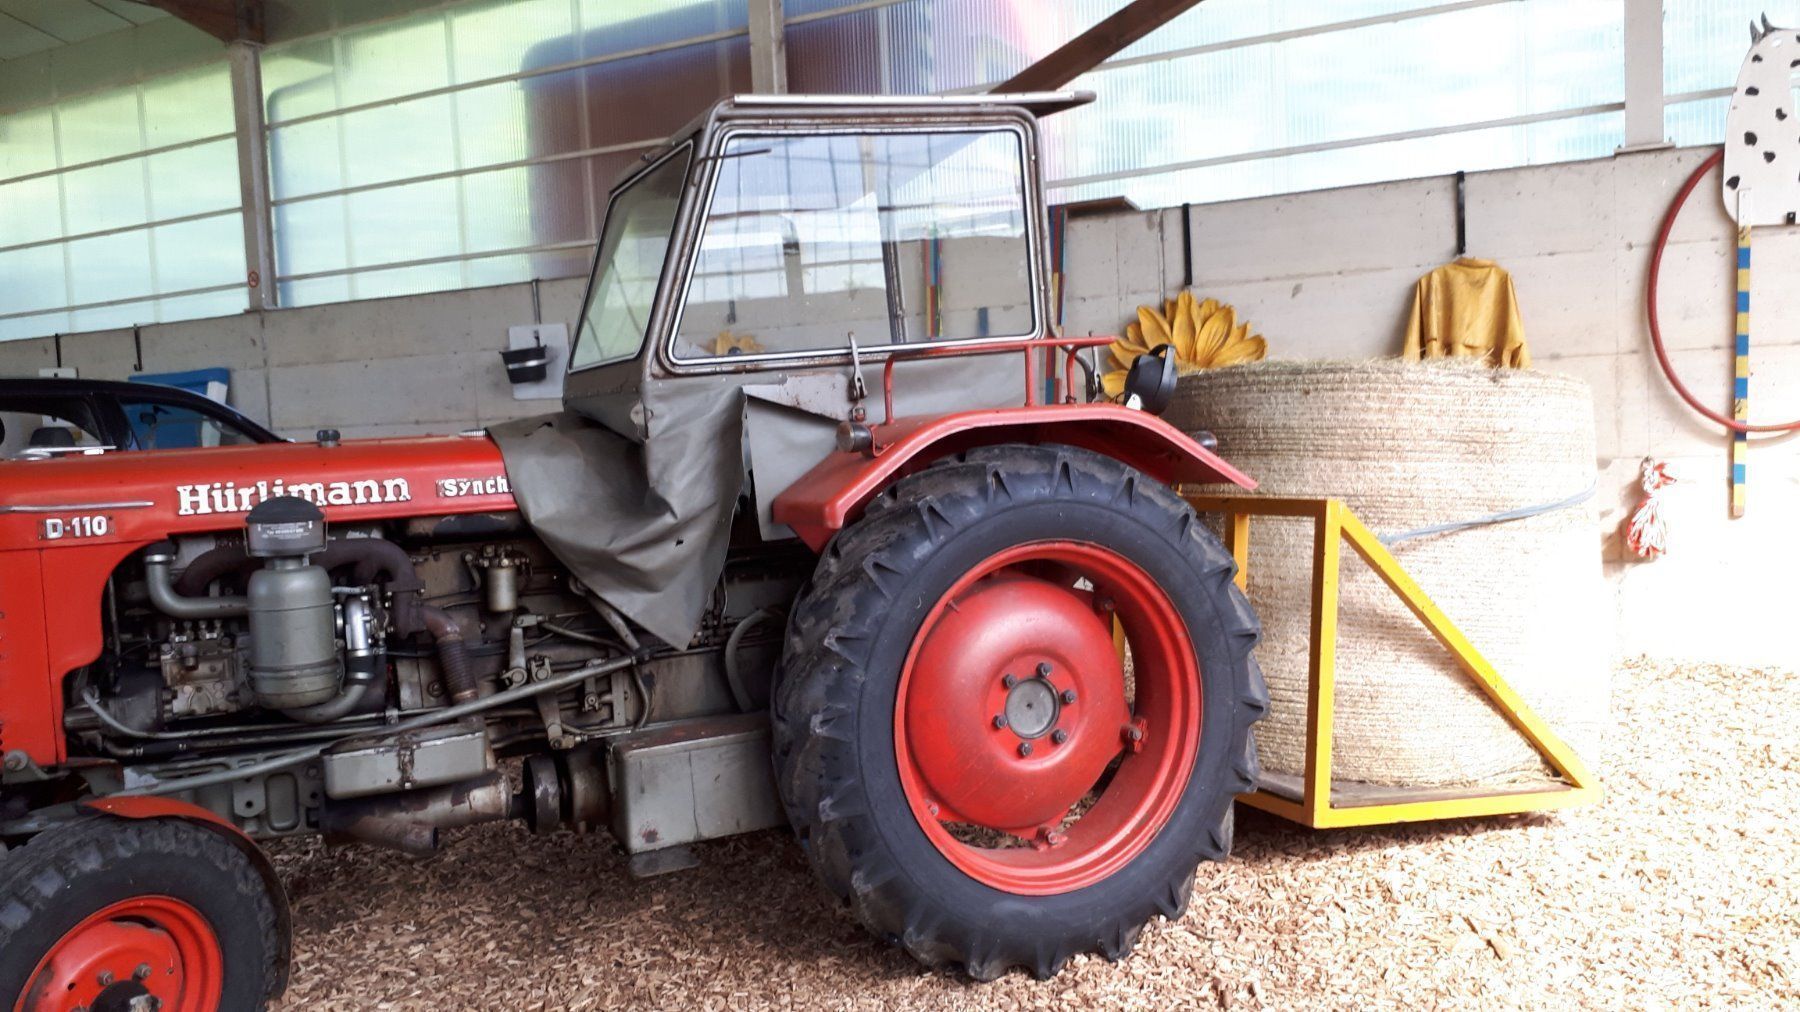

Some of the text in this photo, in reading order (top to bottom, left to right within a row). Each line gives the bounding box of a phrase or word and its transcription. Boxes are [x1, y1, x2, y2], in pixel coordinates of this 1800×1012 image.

[176, 477, 411, 515] Hürlimann
[443, 475, 511, 497] Synch
[45, 516, 108, 539] D-110
